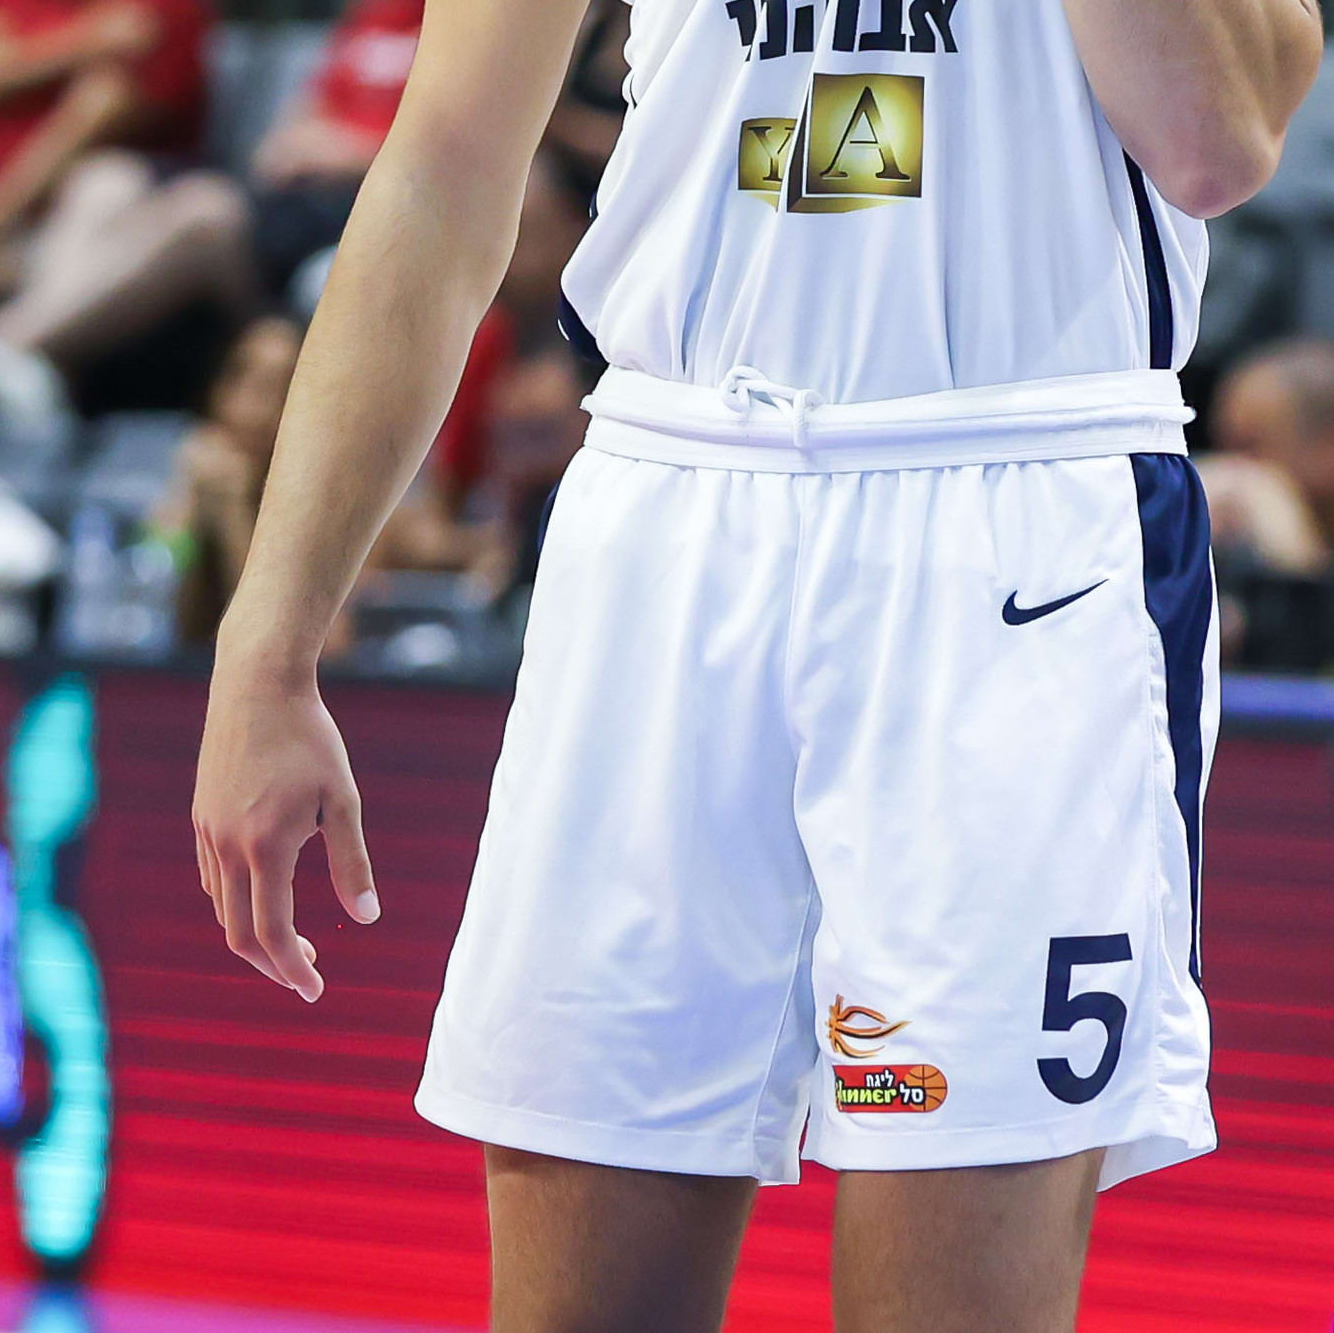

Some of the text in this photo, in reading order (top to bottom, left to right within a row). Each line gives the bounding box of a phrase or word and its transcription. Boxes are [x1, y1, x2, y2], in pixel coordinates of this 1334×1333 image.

[747, 85, 913, 183] Y A
[1035, 932, 1134, 1105] 5
[899, 1082, 925, 1104] סל
